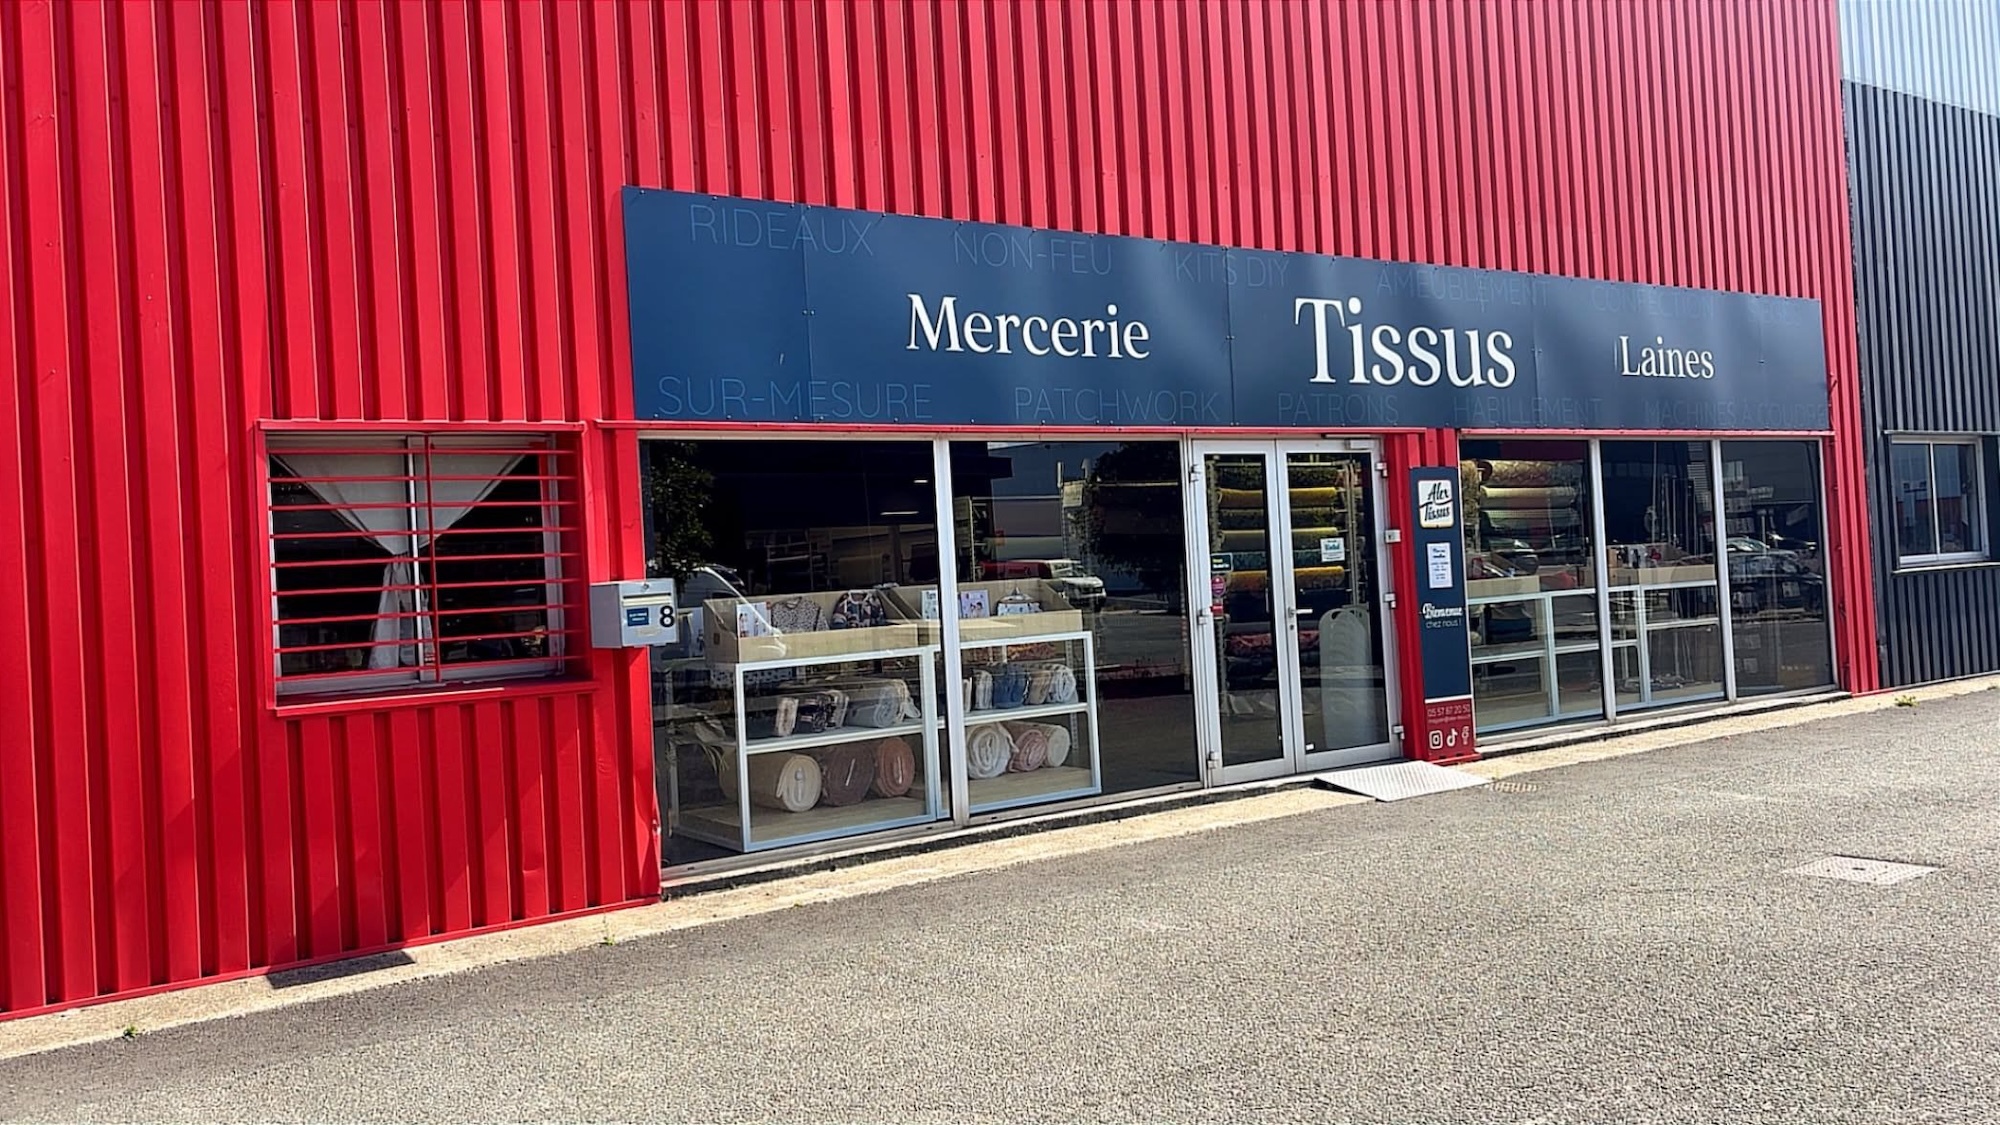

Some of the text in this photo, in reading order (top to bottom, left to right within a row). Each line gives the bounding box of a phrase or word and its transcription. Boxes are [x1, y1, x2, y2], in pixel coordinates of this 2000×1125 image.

[690, 204, 873, 255] RIDEAUX
[953, 230, 1112, 276] NON-FEU
[1175, 251, 1289, 287] KITS DIY
[1376, 268, 1551, 307] AMEUBLEMENT
[1591, 285, 1714, 320] CONFECTION
[907, 293, 1150, 358] Mercerie
[1295, 297, 1517, 388] Tissus
[1620, 335, 1715, 379] Laines
[657, 376, 933, 419] SUR-MESURE
[1015, 387, 1220, 422] PATCHWORK
[1277, 392, 1399, 425] PATRONS
[1453, 397, 1603, 425] HABILLEMENT
[1645, 400, 1736, 427] MACHINES
[1427, 482, 1449, 502] Alex
[1420, 501, 1450, 521] Tissus
[660, 605, 675, 627] 8
